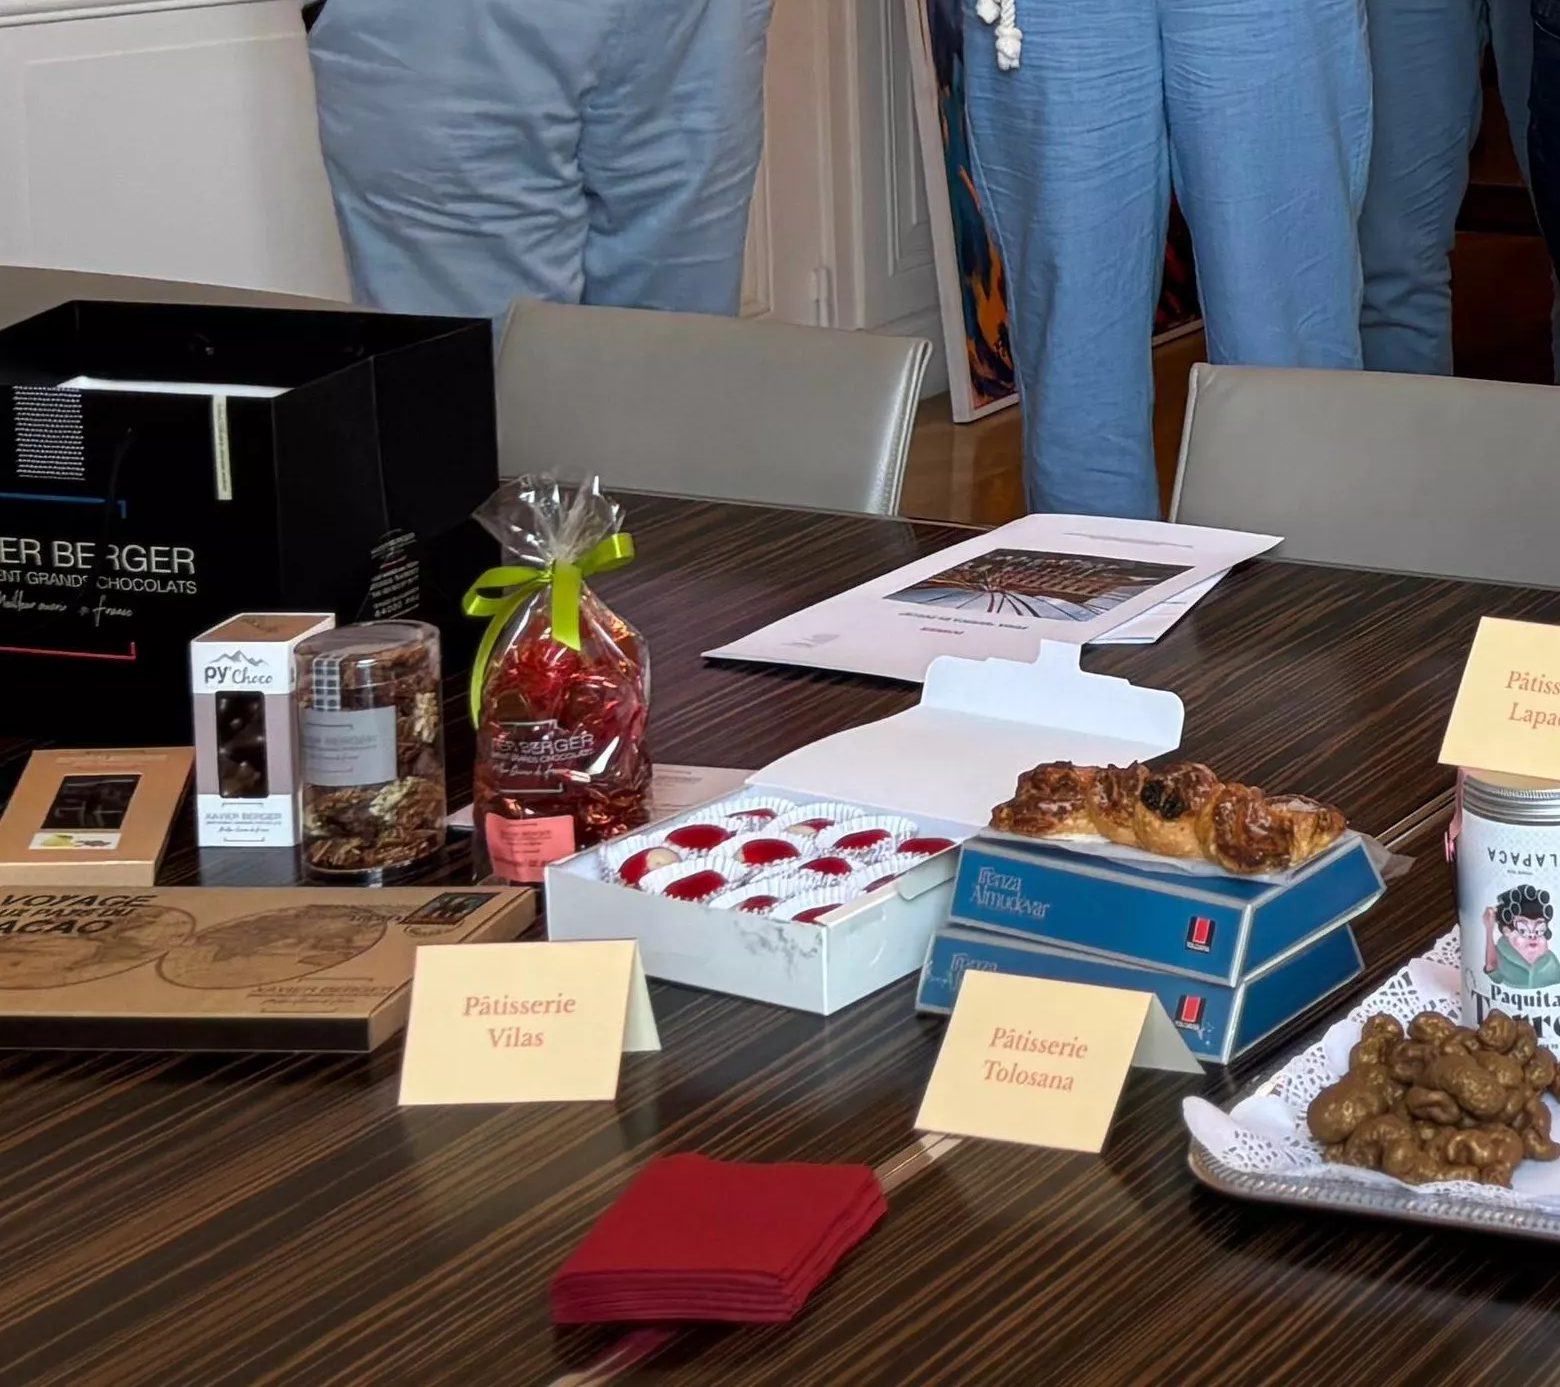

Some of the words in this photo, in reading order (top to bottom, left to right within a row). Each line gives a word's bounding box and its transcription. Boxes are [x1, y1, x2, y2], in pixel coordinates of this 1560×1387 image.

[1487, 846, 1558, 868] LAPACA
[1, 894, 158, 907] VOYAGE
[462, 993, 577, 1017] Pâtisserie
[487, 1026, 545, 1049] Vilas
[988, 1026, 1089, 1060] Pâtisserie
[983, 1058, 1075, 1092] Tolosana
